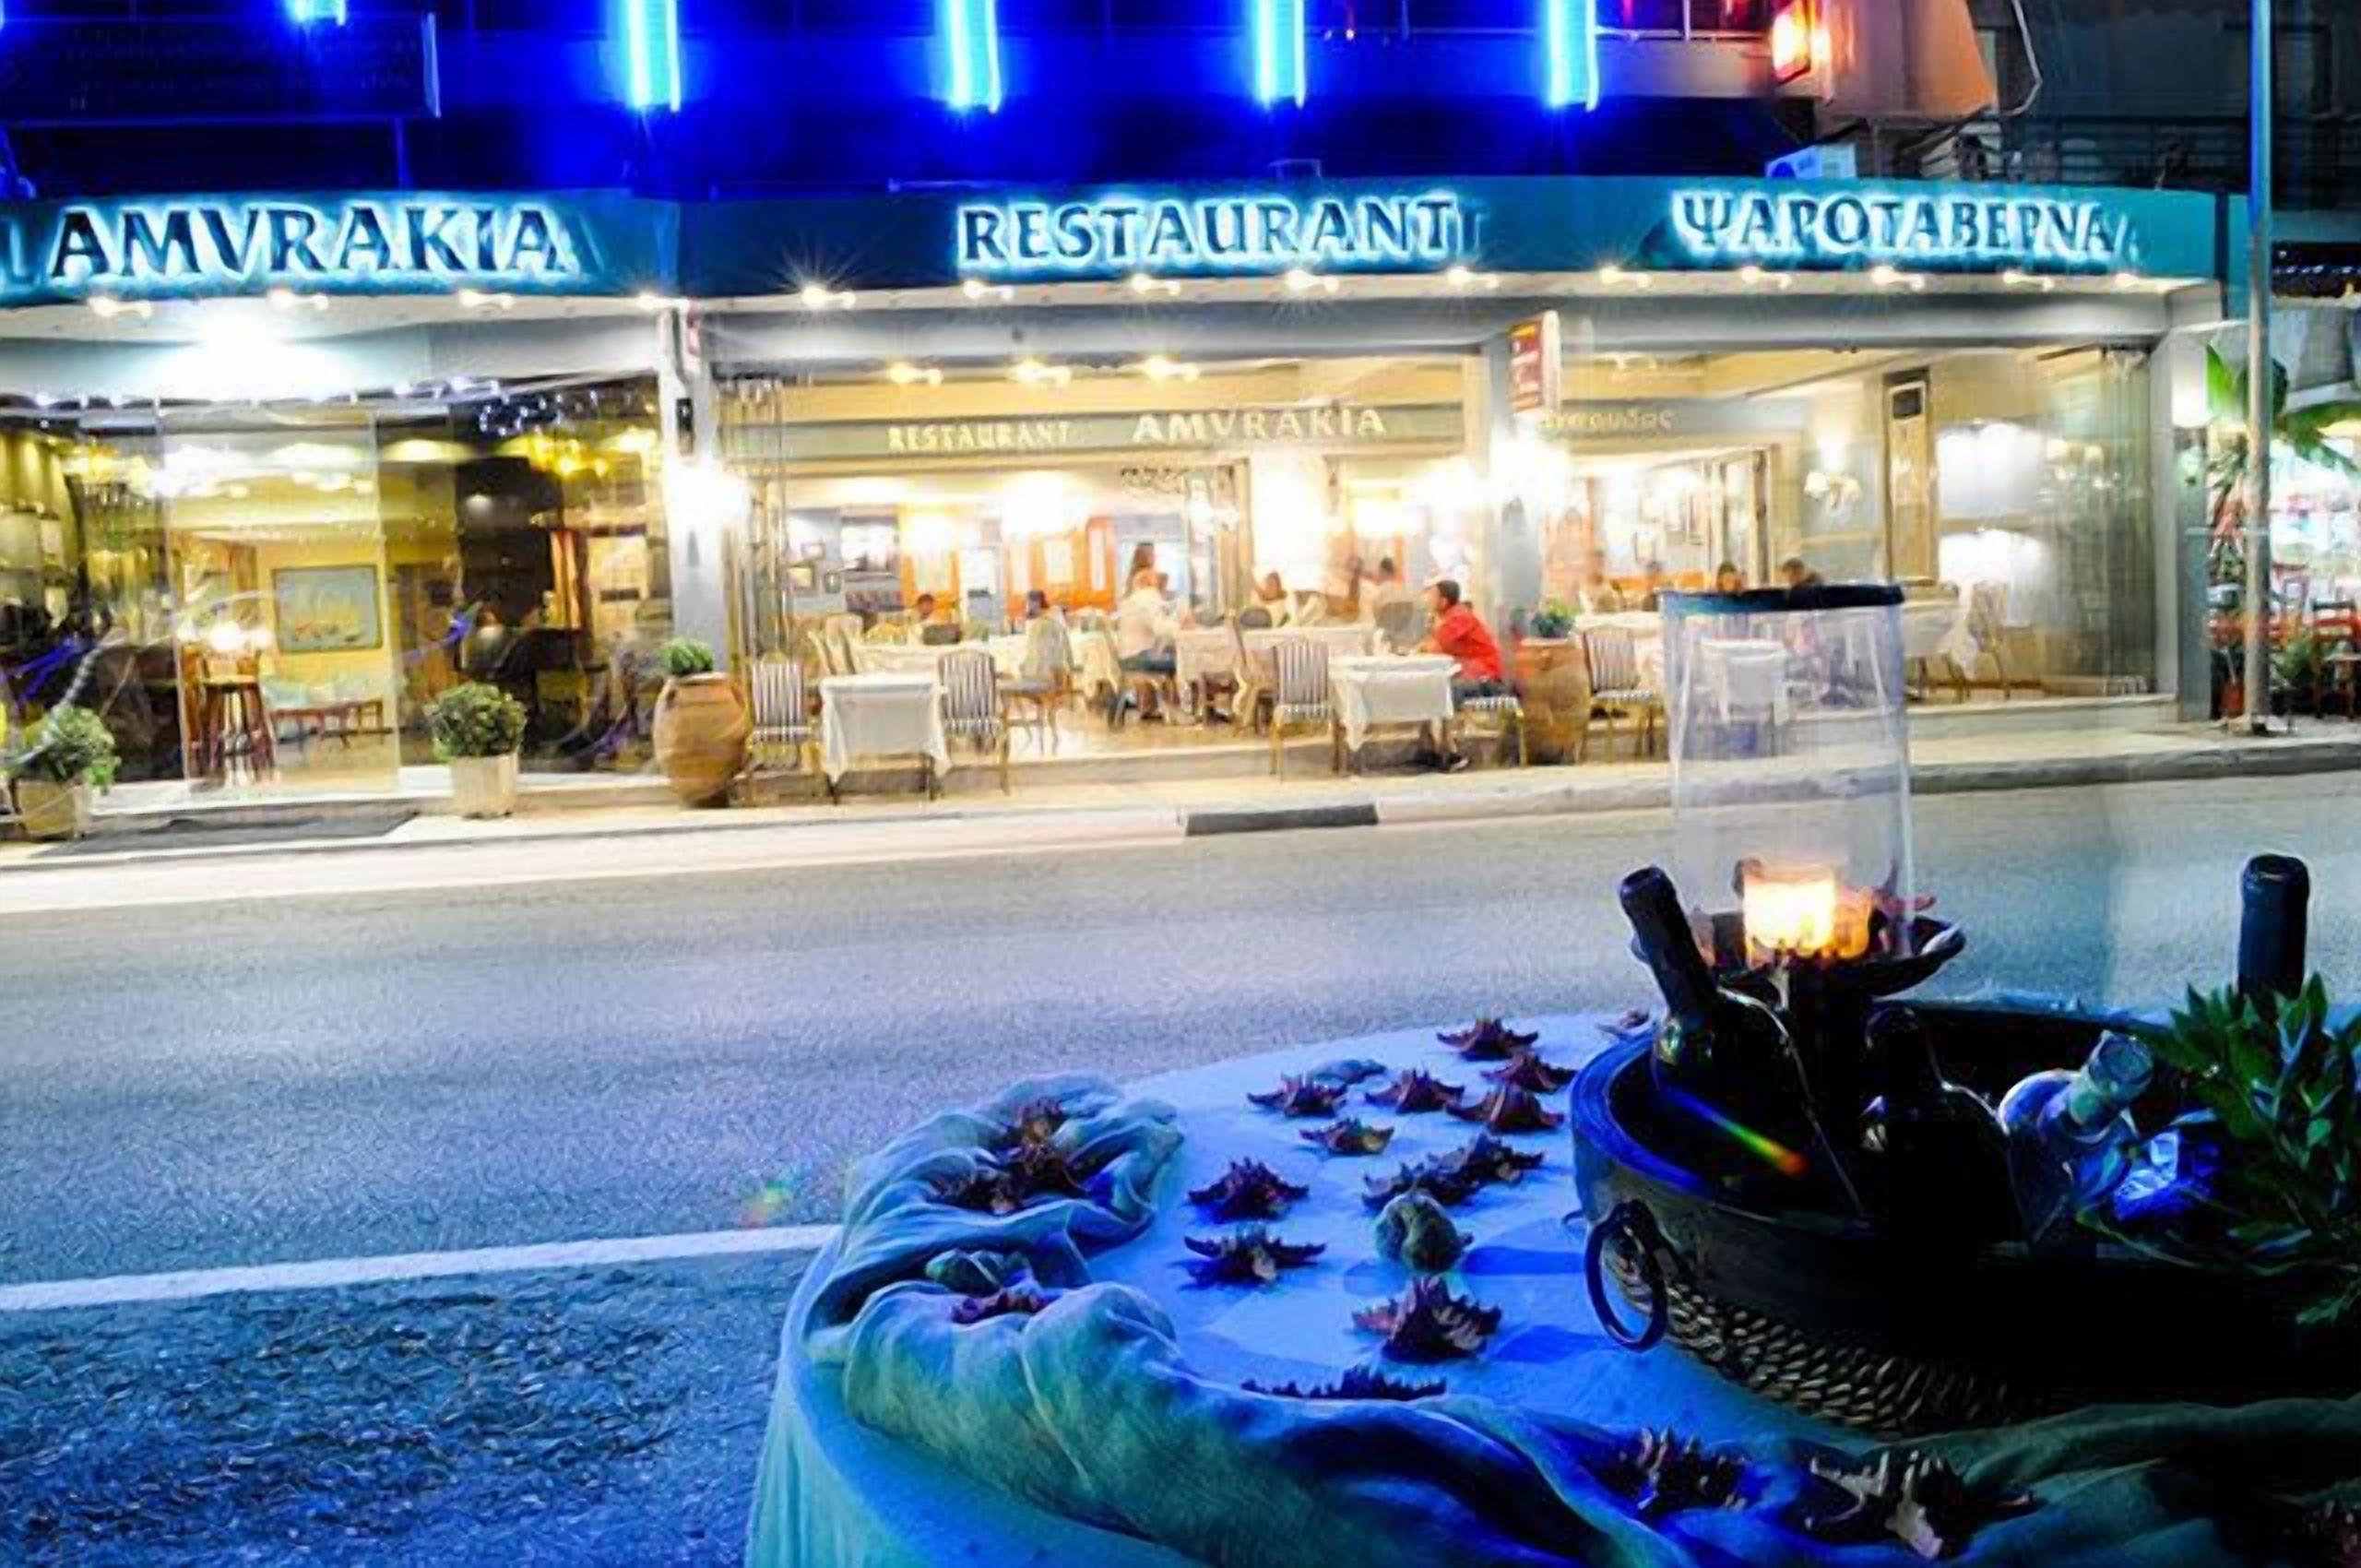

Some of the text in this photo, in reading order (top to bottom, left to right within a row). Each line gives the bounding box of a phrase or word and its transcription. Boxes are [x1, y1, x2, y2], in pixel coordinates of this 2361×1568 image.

[50, 206, 570, 278] AMVRAKIA
[962, 199, 1453, 262] RESTAURANT
[1680, 196, 2116, 253] ΨΑΡΟΤΑΒΕΡΝΑ
[887, 408, 1386, 452] RESTAURANT AMVRAKIA
